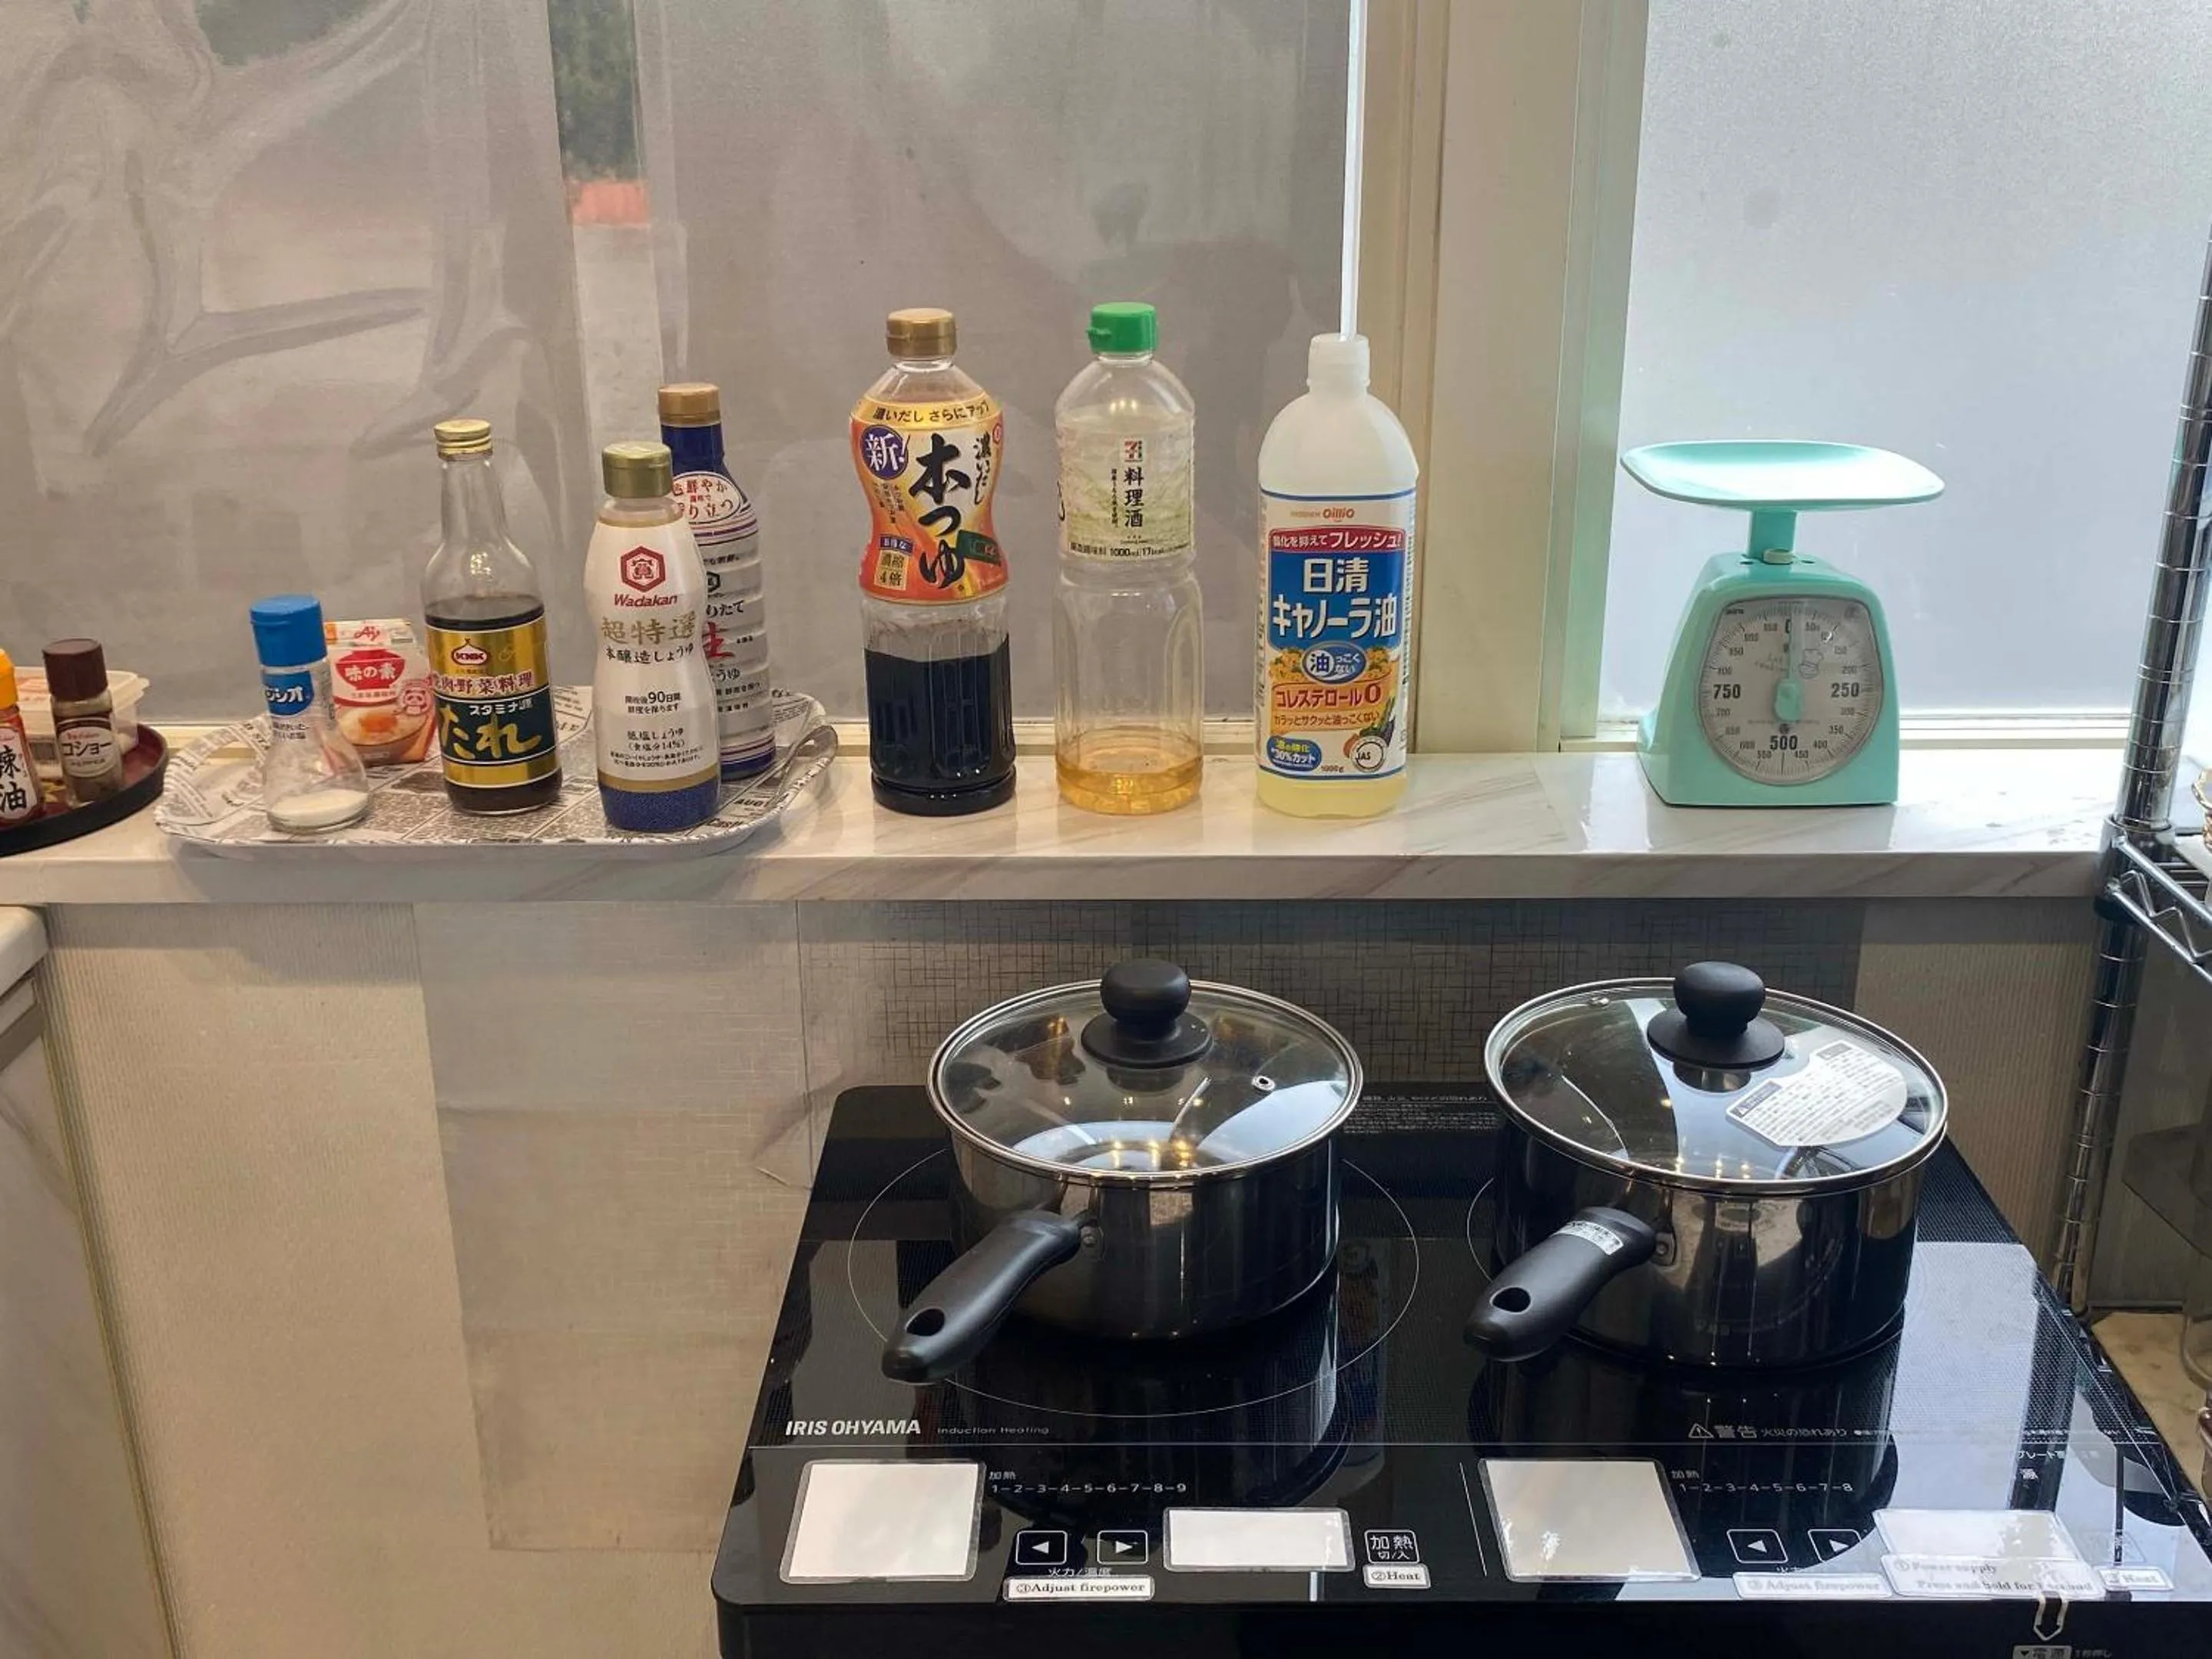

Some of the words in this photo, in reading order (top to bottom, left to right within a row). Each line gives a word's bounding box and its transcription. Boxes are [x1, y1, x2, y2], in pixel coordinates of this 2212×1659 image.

[1124, 466, 1144, 528] 料理酒
[909, 433, 972, 589] 本つゆ
[1303, 557, 1369, 593] 日清
[614, 594, 677, 607] Wadakan
[1273, 593, 1398, 637] キャノーラ油
[601, 611, 695, 645] 超特選
[1714, 684, 1741, 699] 750
[1831, 682, 1859, 697] 250
[439, 704, 541, 760] たれ
[61, 741, 111, 757] コショー
[1770, 735, 1798, 750] 500
[1356, 752, 1371, 760] JAS
[786, 1421, 826, 1435] IRIS
[831, 1419, 921, 1435] OHYAMA
[1000, 1427, 1050, 1435] Heating
[1369, 1535, 1413, 1550] 加熱
[1081, 1582, 1145, 1593] firepower
